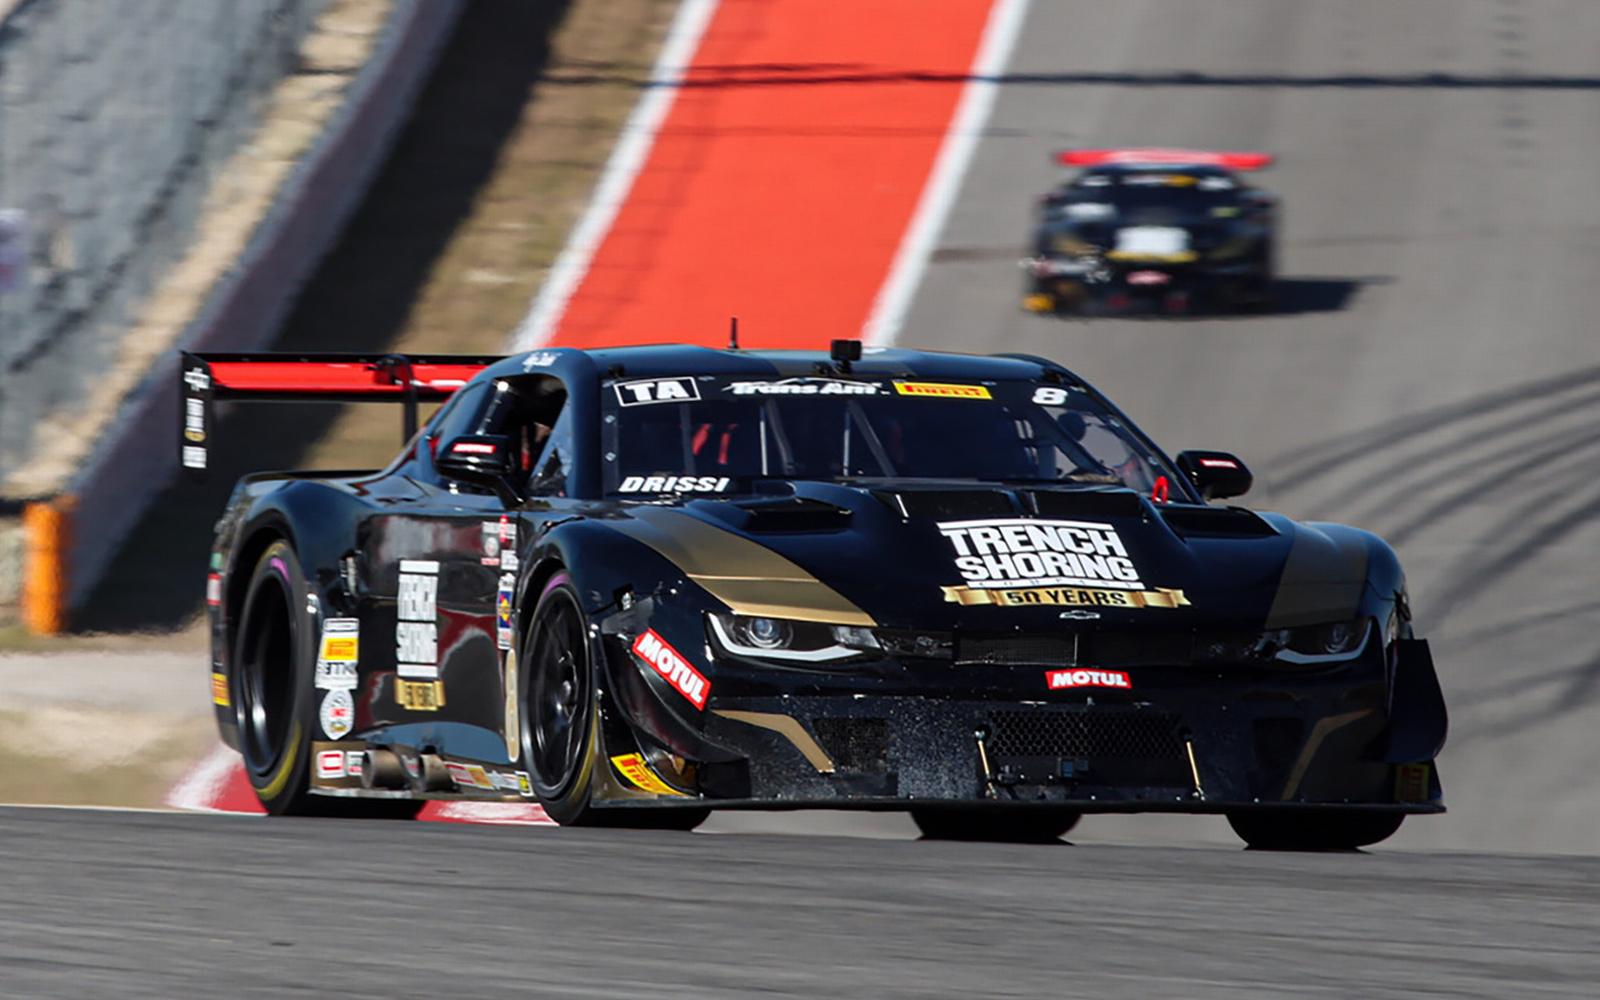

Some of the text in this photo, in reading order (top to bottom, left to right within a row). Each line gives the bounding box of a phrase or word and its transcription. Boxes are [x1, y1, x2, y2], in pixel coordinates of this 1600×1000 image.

[625, 380, 690, 402] TA
[732, 381, 817, 395] Trans
[1031, 386, 1069, 406] 8
[617, 475, 731, 493] DRISSI
[940, 524, 1129, 558] TRENCH
[954, 552, 1140, 582] SHORING
[1006, 590, 1128, 606] 50 YEARS
[636, 631, 705, 704] MOTUL
[1051, 670, 1128, 688] MOTUL
